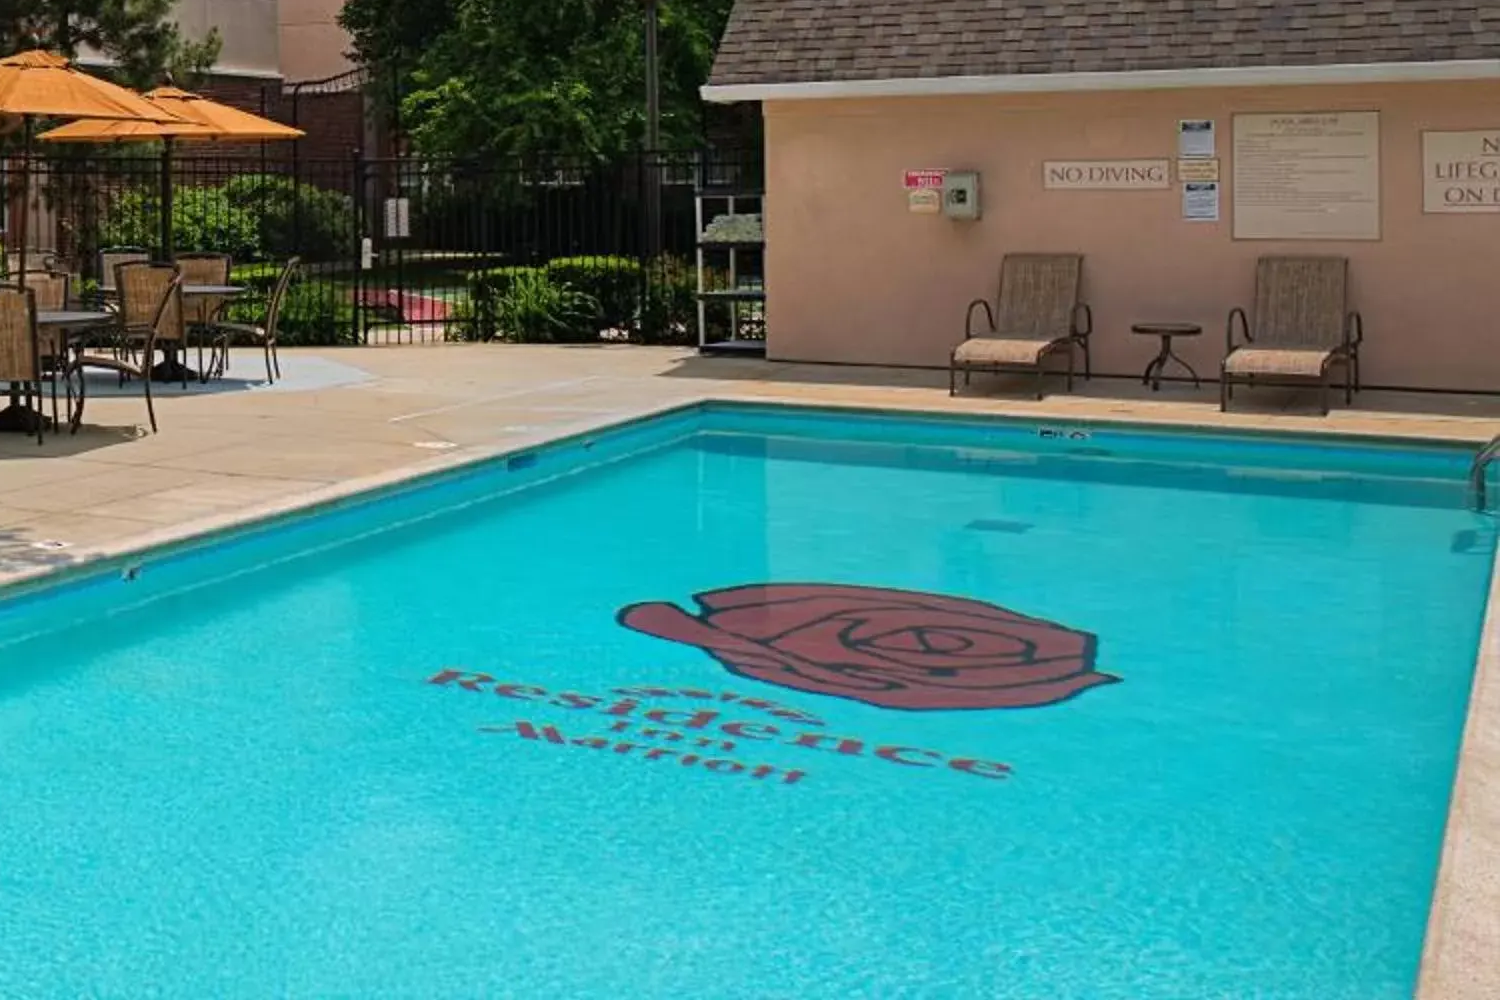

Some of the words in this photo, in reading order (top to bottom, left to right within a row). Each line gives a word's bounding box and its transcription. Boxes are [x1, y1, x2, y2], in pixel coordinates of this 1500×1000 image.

[1050, 167, 1083, 183] NO
[1088, 166, 1163, 182] DIVING
[1444, 186, 1483, 202] ON
[426, 669, 1014, 779] Residence
